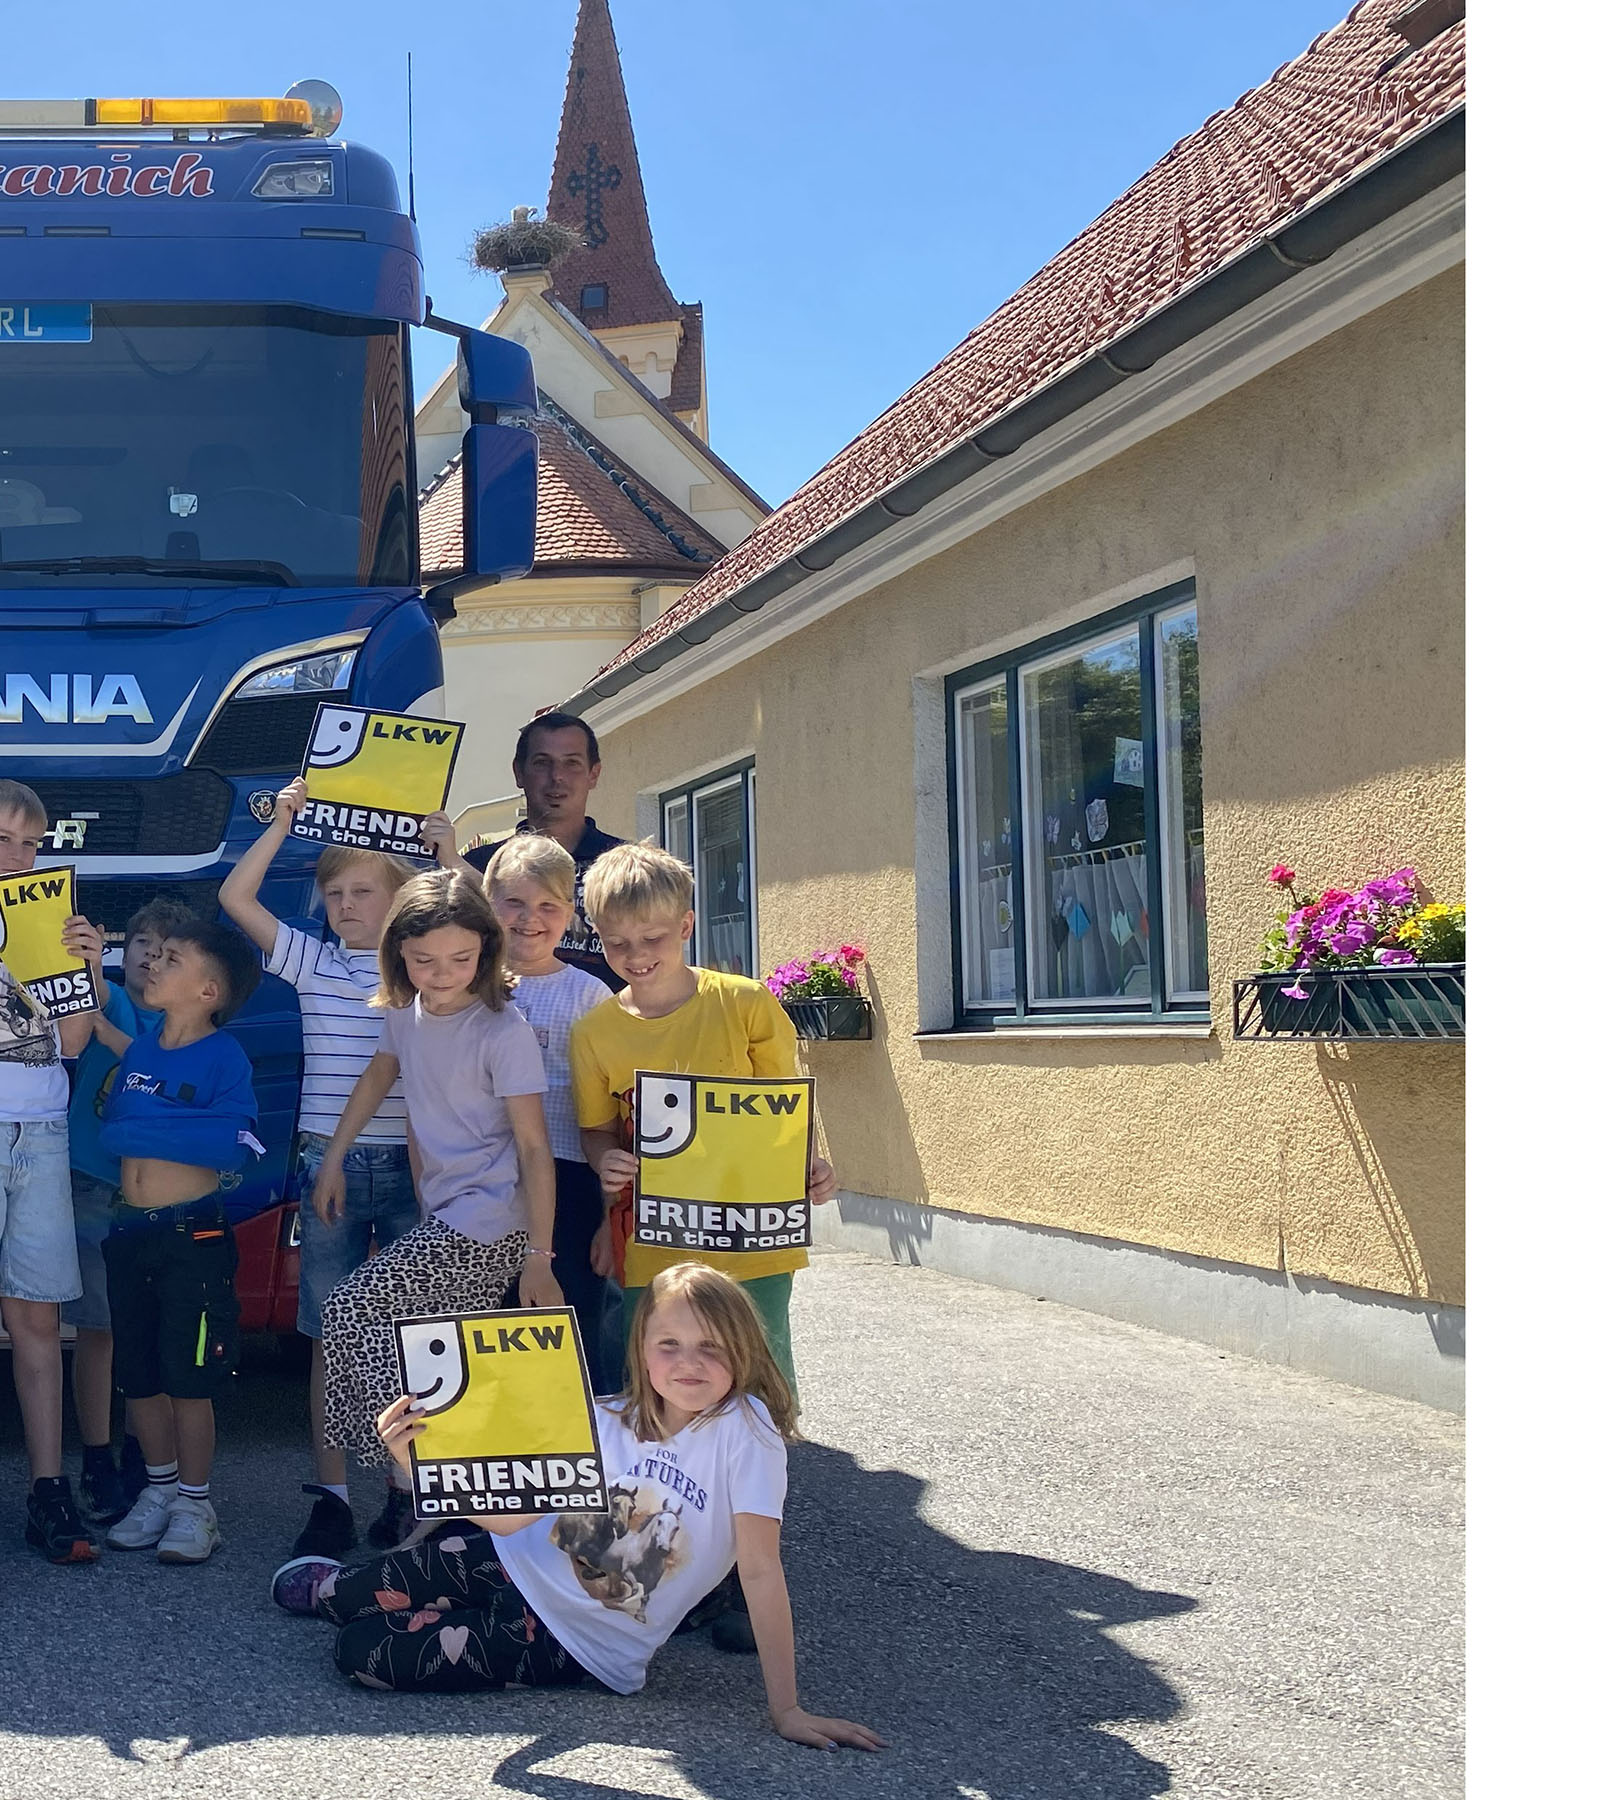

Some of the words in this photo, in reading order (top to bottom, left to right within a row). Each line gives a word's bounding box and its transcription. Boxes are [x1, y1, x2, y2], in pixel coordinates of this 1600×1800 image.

[372, 722, 452, 745] LKW
[294, 824, 322, 839] on
[331, 829, 371, 846] the
[3, 878, 65, 907] LKW
[51, 994, 93, 1015] road
[705, 1091, 802, 1116] LKW
[639, 1200, 807, 1232] FRIENDS
[639, 1229, 672, 1243] on
[683, 1230, 732, 1249] the
[743, 1229, 806, 1249] road
[473, 1325, 566, 1355] LKW
[656, 1448, 679, 1464] FOR
[418, 1458, 601, 1494] FRIENDS
[421, 1497, 460, 1513] on
[473, 1492, 522, 1511] the
[534, 1489, 603, 1509] road
